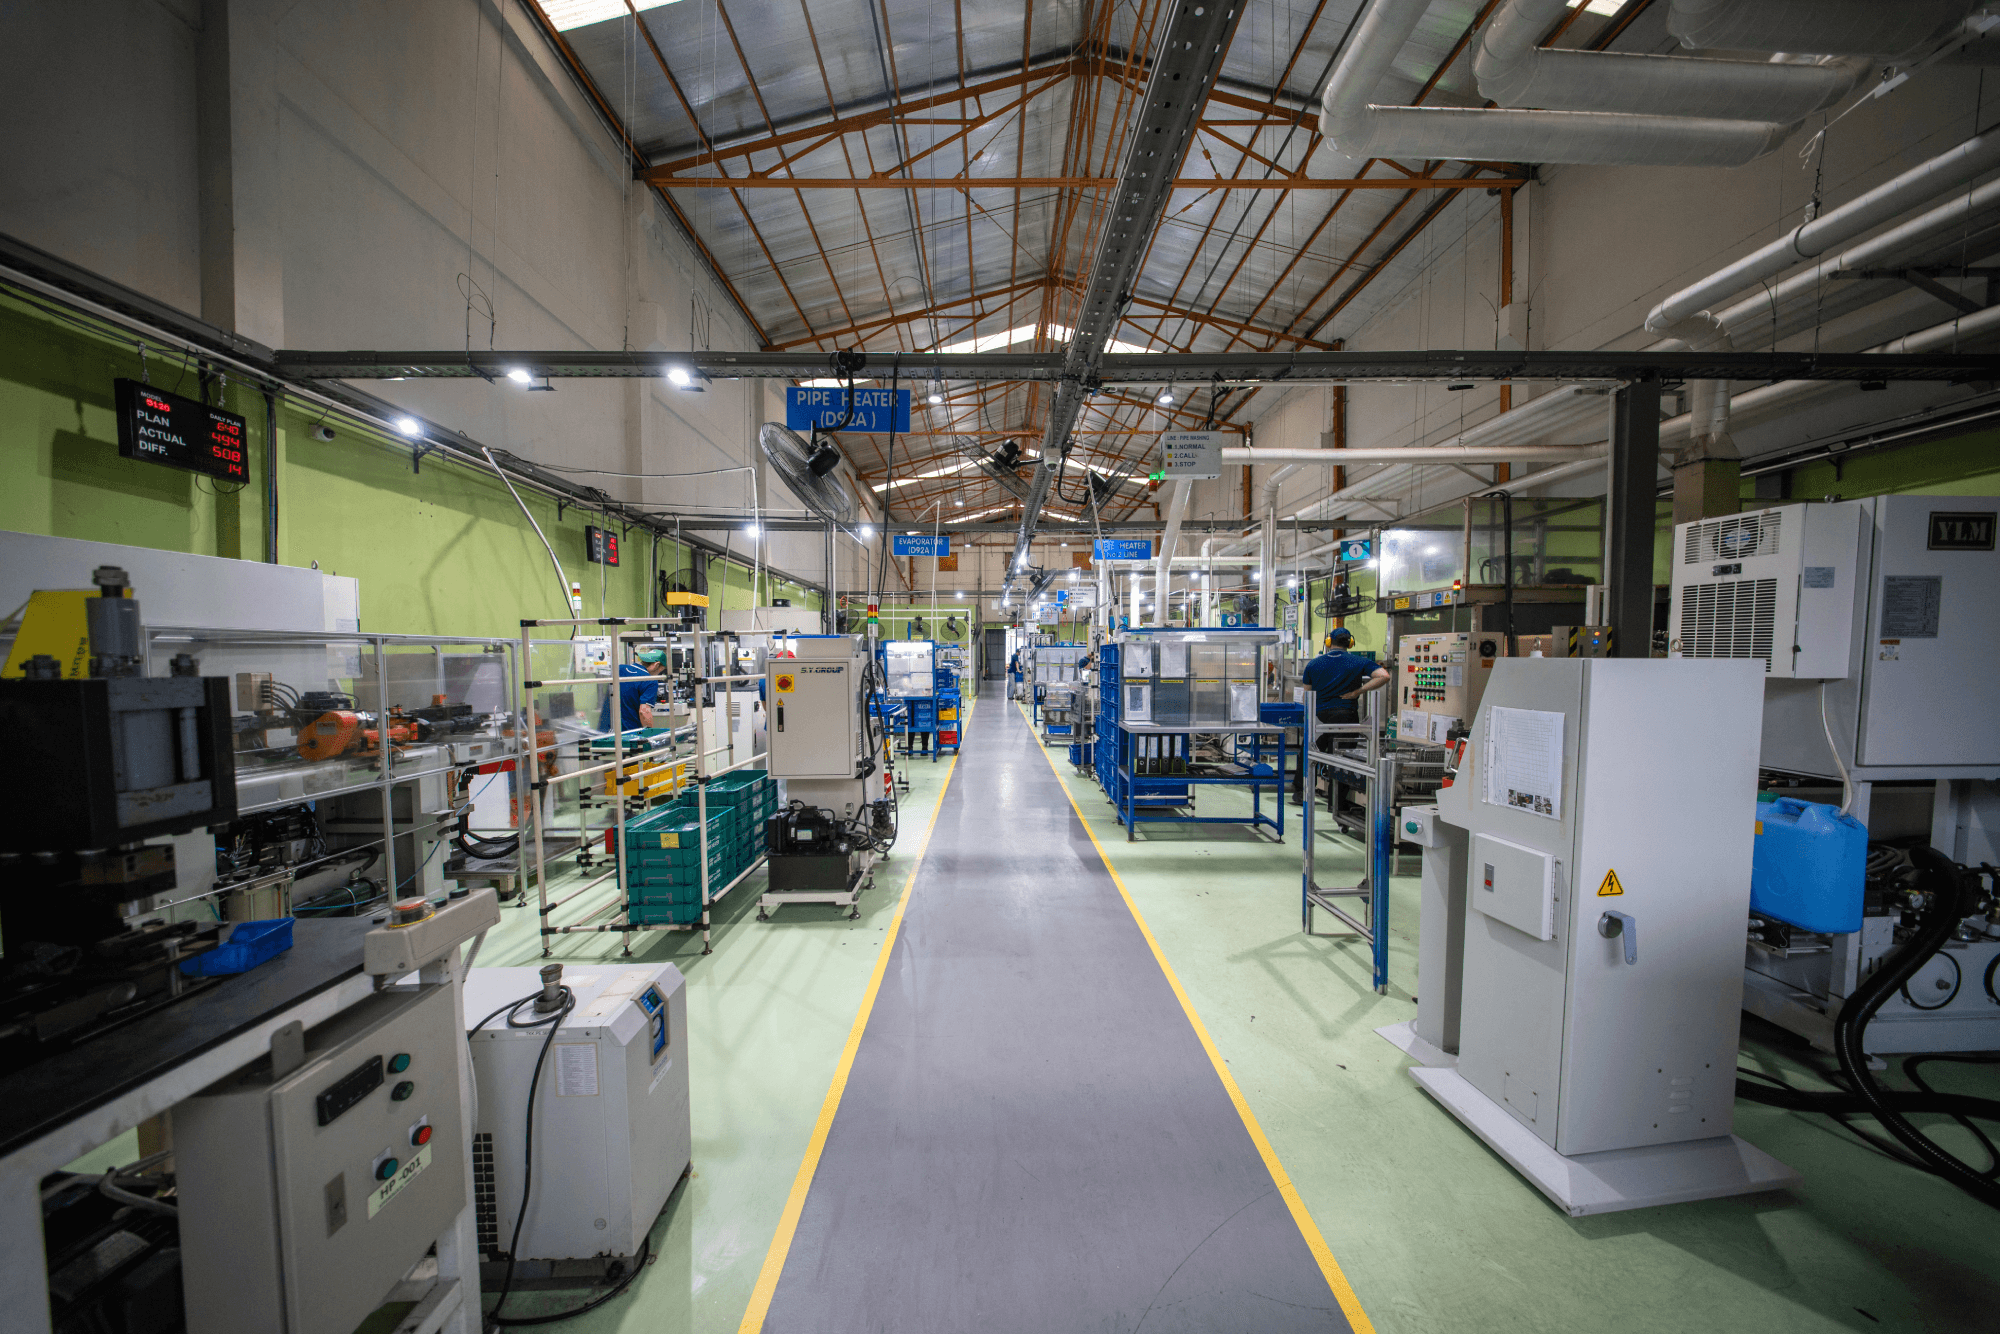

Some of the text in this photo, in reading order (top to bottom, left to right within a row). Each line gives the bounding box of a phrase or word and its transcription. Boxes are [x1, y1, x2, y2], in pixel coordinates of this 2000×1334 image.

[140, 391, 163, 402] MODEL
[797, 390, 899, 408] PIPE HEATER
[136, 409, 170, 427] PLAN
[209, 413, 242, 428] DAILY PLAN
[138, 426, 187, 446] ACTUAL
[216, 422, 239, 435] 640
[139, 440, 169, 456] DIFF.
[211, 432, 240, 448] 494
[212, 445, 241, 462] 508
[228, 463, 242, 475] 14
[1938, 521, 1988, 541] YLM
[380, 1179, 396, 1199] HP
